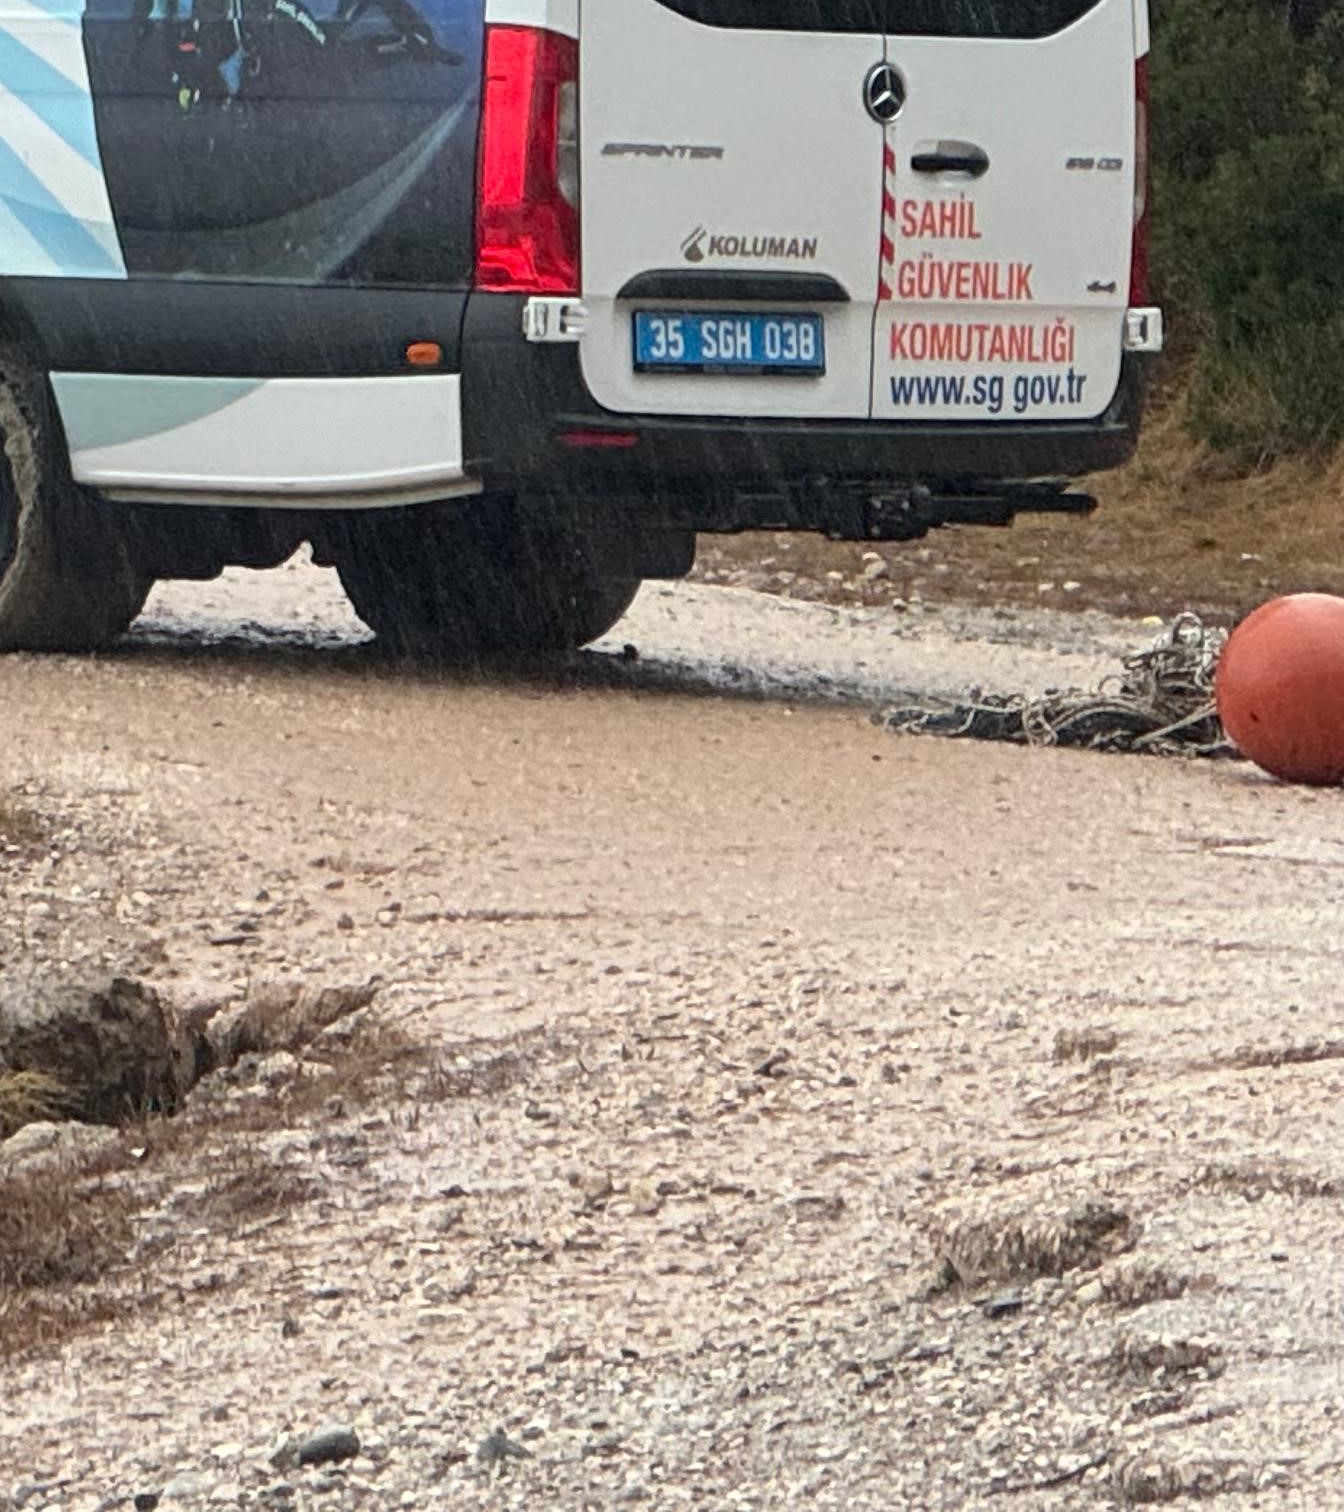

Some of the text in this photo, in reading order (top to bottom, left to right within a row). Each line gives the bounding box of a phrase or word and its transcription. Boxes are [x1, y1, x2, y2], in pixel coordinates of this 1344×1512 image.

[901, 190, 982, 240] SAHİL
[708, 237, 818, 259] KOLUMAN
[650, 319, 815, 360] 35 SGH 038
[890, 317, 1074, 364] KOMUTANLIĞI
